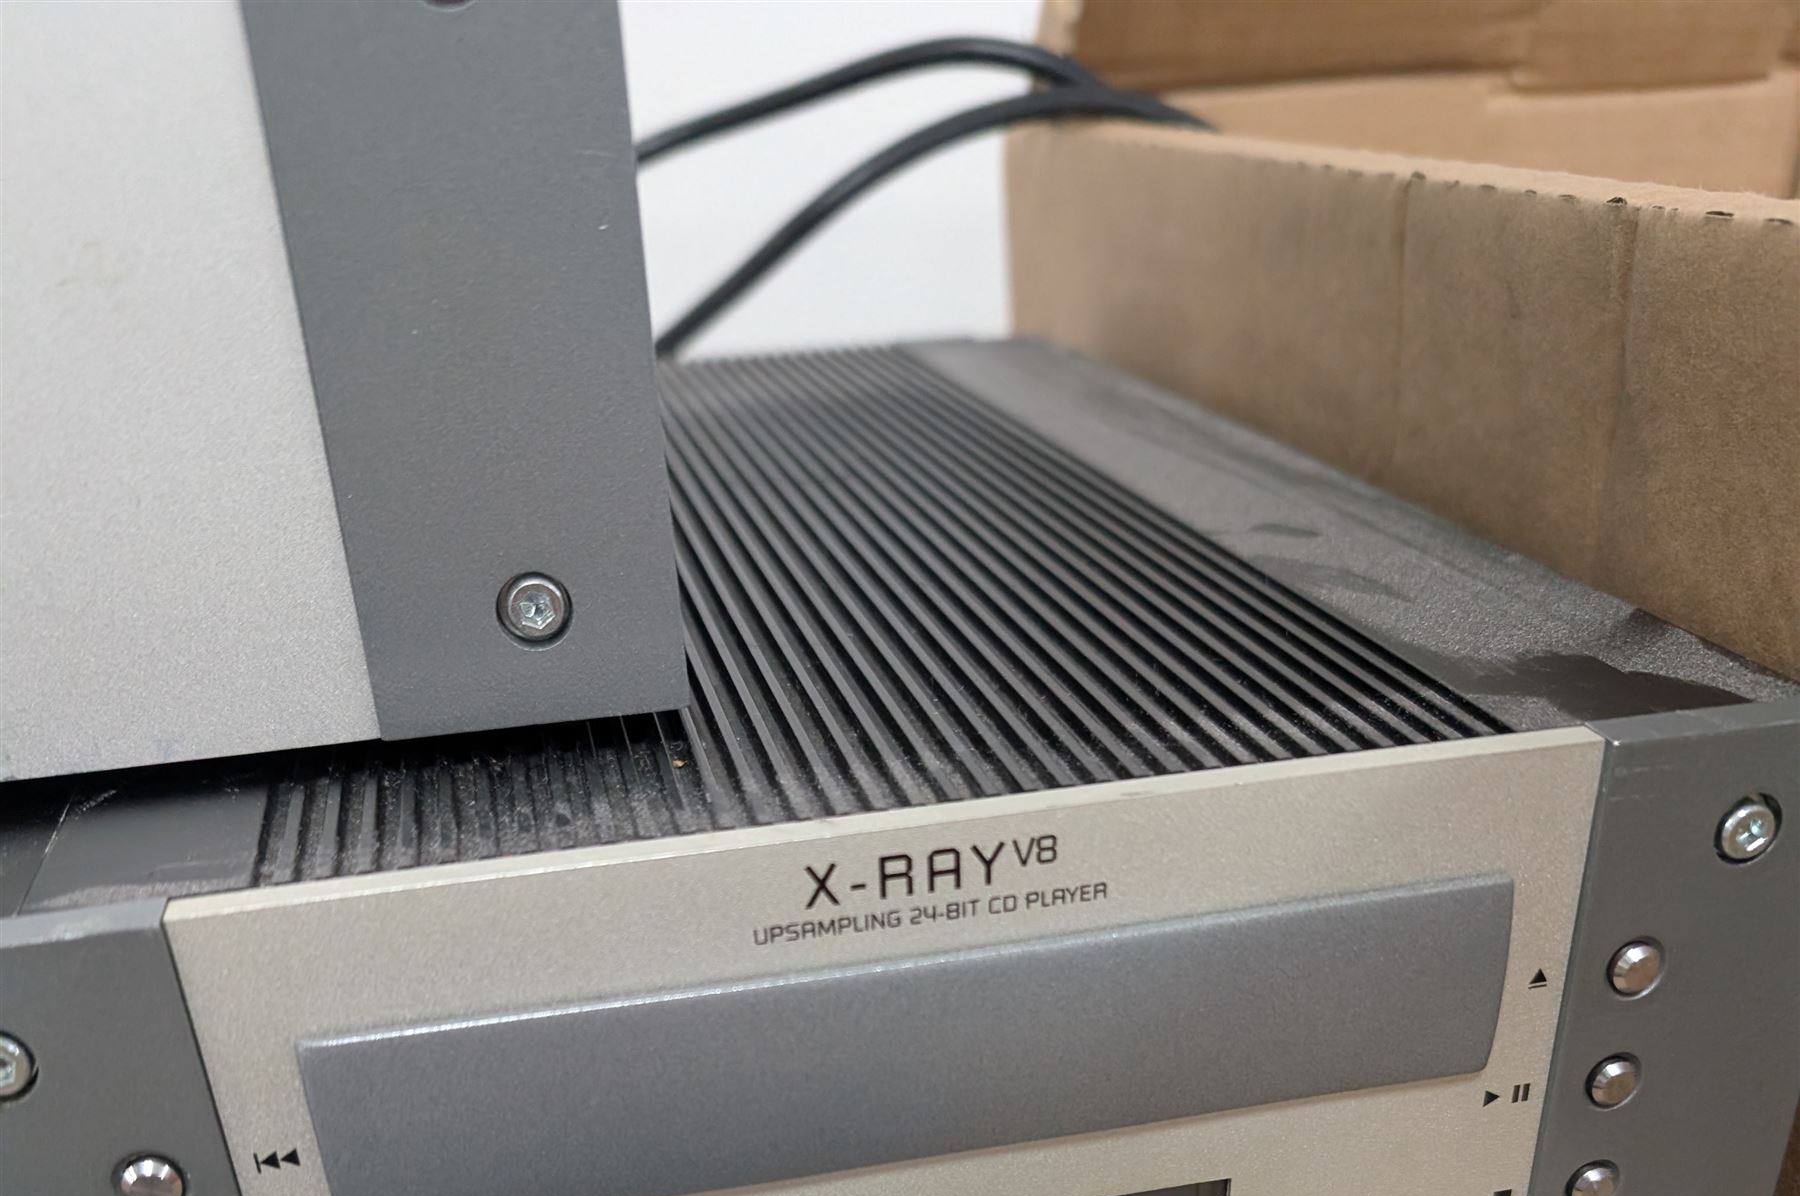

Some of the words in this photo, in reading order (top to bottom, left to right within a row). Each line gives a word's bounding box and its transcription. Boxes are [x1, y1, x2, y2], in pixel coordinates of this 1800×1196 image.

[805, 841, 1004, 910] X-RAY
[1012, 834, 1058, 867] V8
[752, 909, 901, 946] UPSAMPLING
[909, 898, 981, 926] 24-BIT
[987, 895, 1018, 915] CD
[1025, 882, 1108, 909] PLAYER
